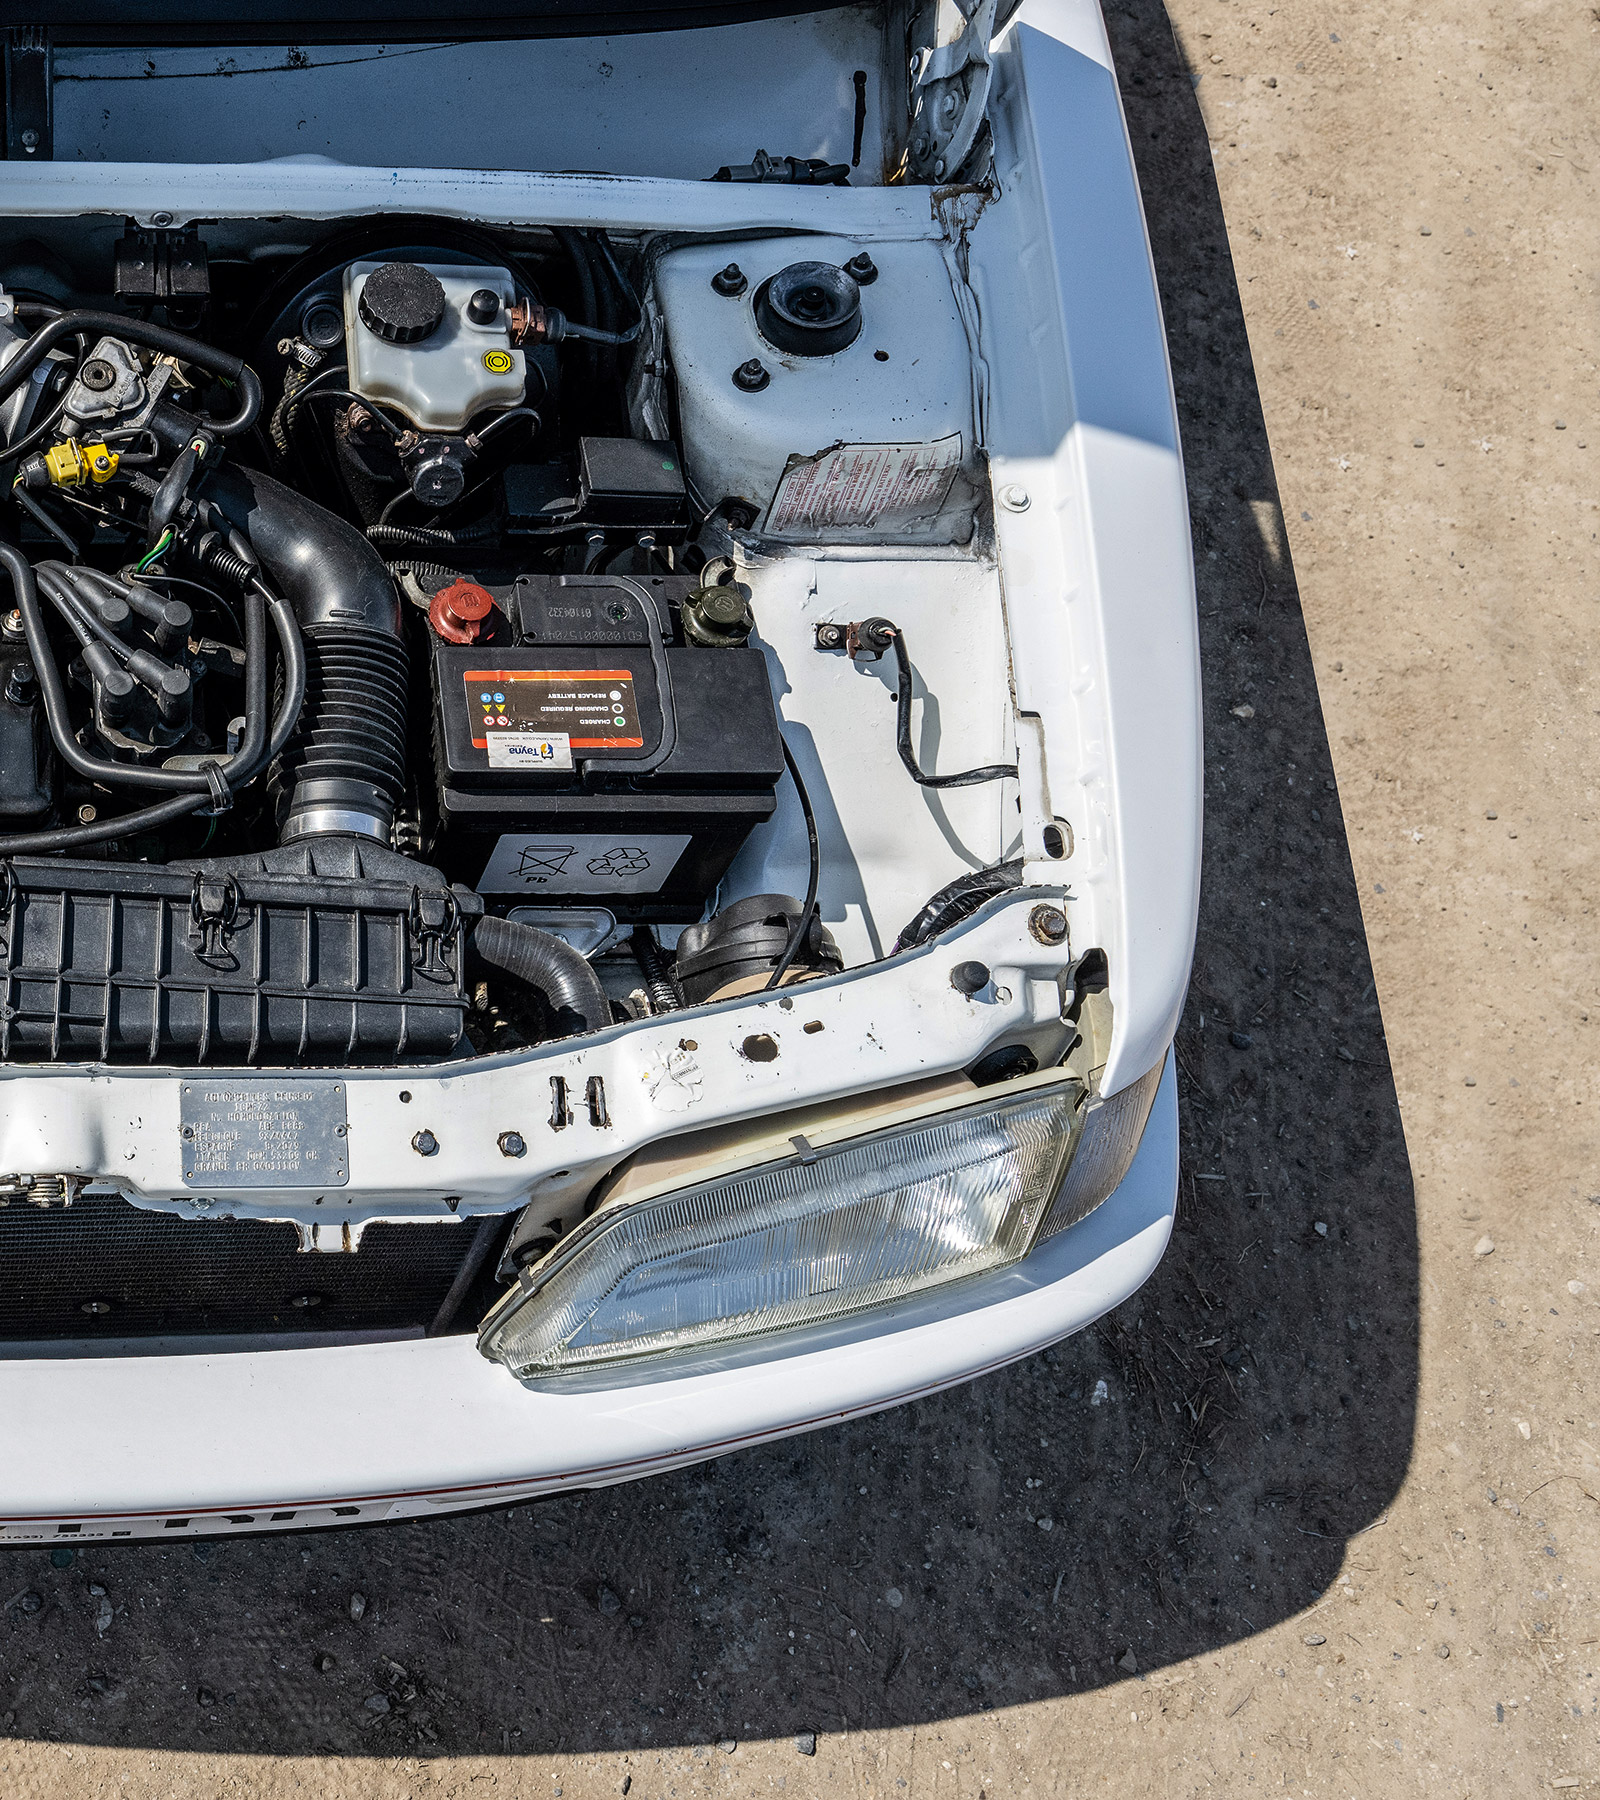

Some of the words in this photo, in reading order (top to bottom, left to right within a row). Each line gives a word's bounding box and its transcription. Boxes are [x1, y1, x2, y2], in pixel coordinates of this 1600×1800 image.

[508, 746, 539, 757] Tayna
[524, 875, 549, 884] Pb
[204, 1091, 271, 1102] AUTOMOBILES
[274, 1091, 314, 1102] PEUGEOT
[227, 1111, 299, 1121] HOMOLOGATION
[193, 1122, 212, 1132] RFA
[194, 1131, 242, 1141] BELGIQUE
[194, 1142, 236, 1152] ESPAGNE
[194, 1162, 230, 1172] GRANDE
